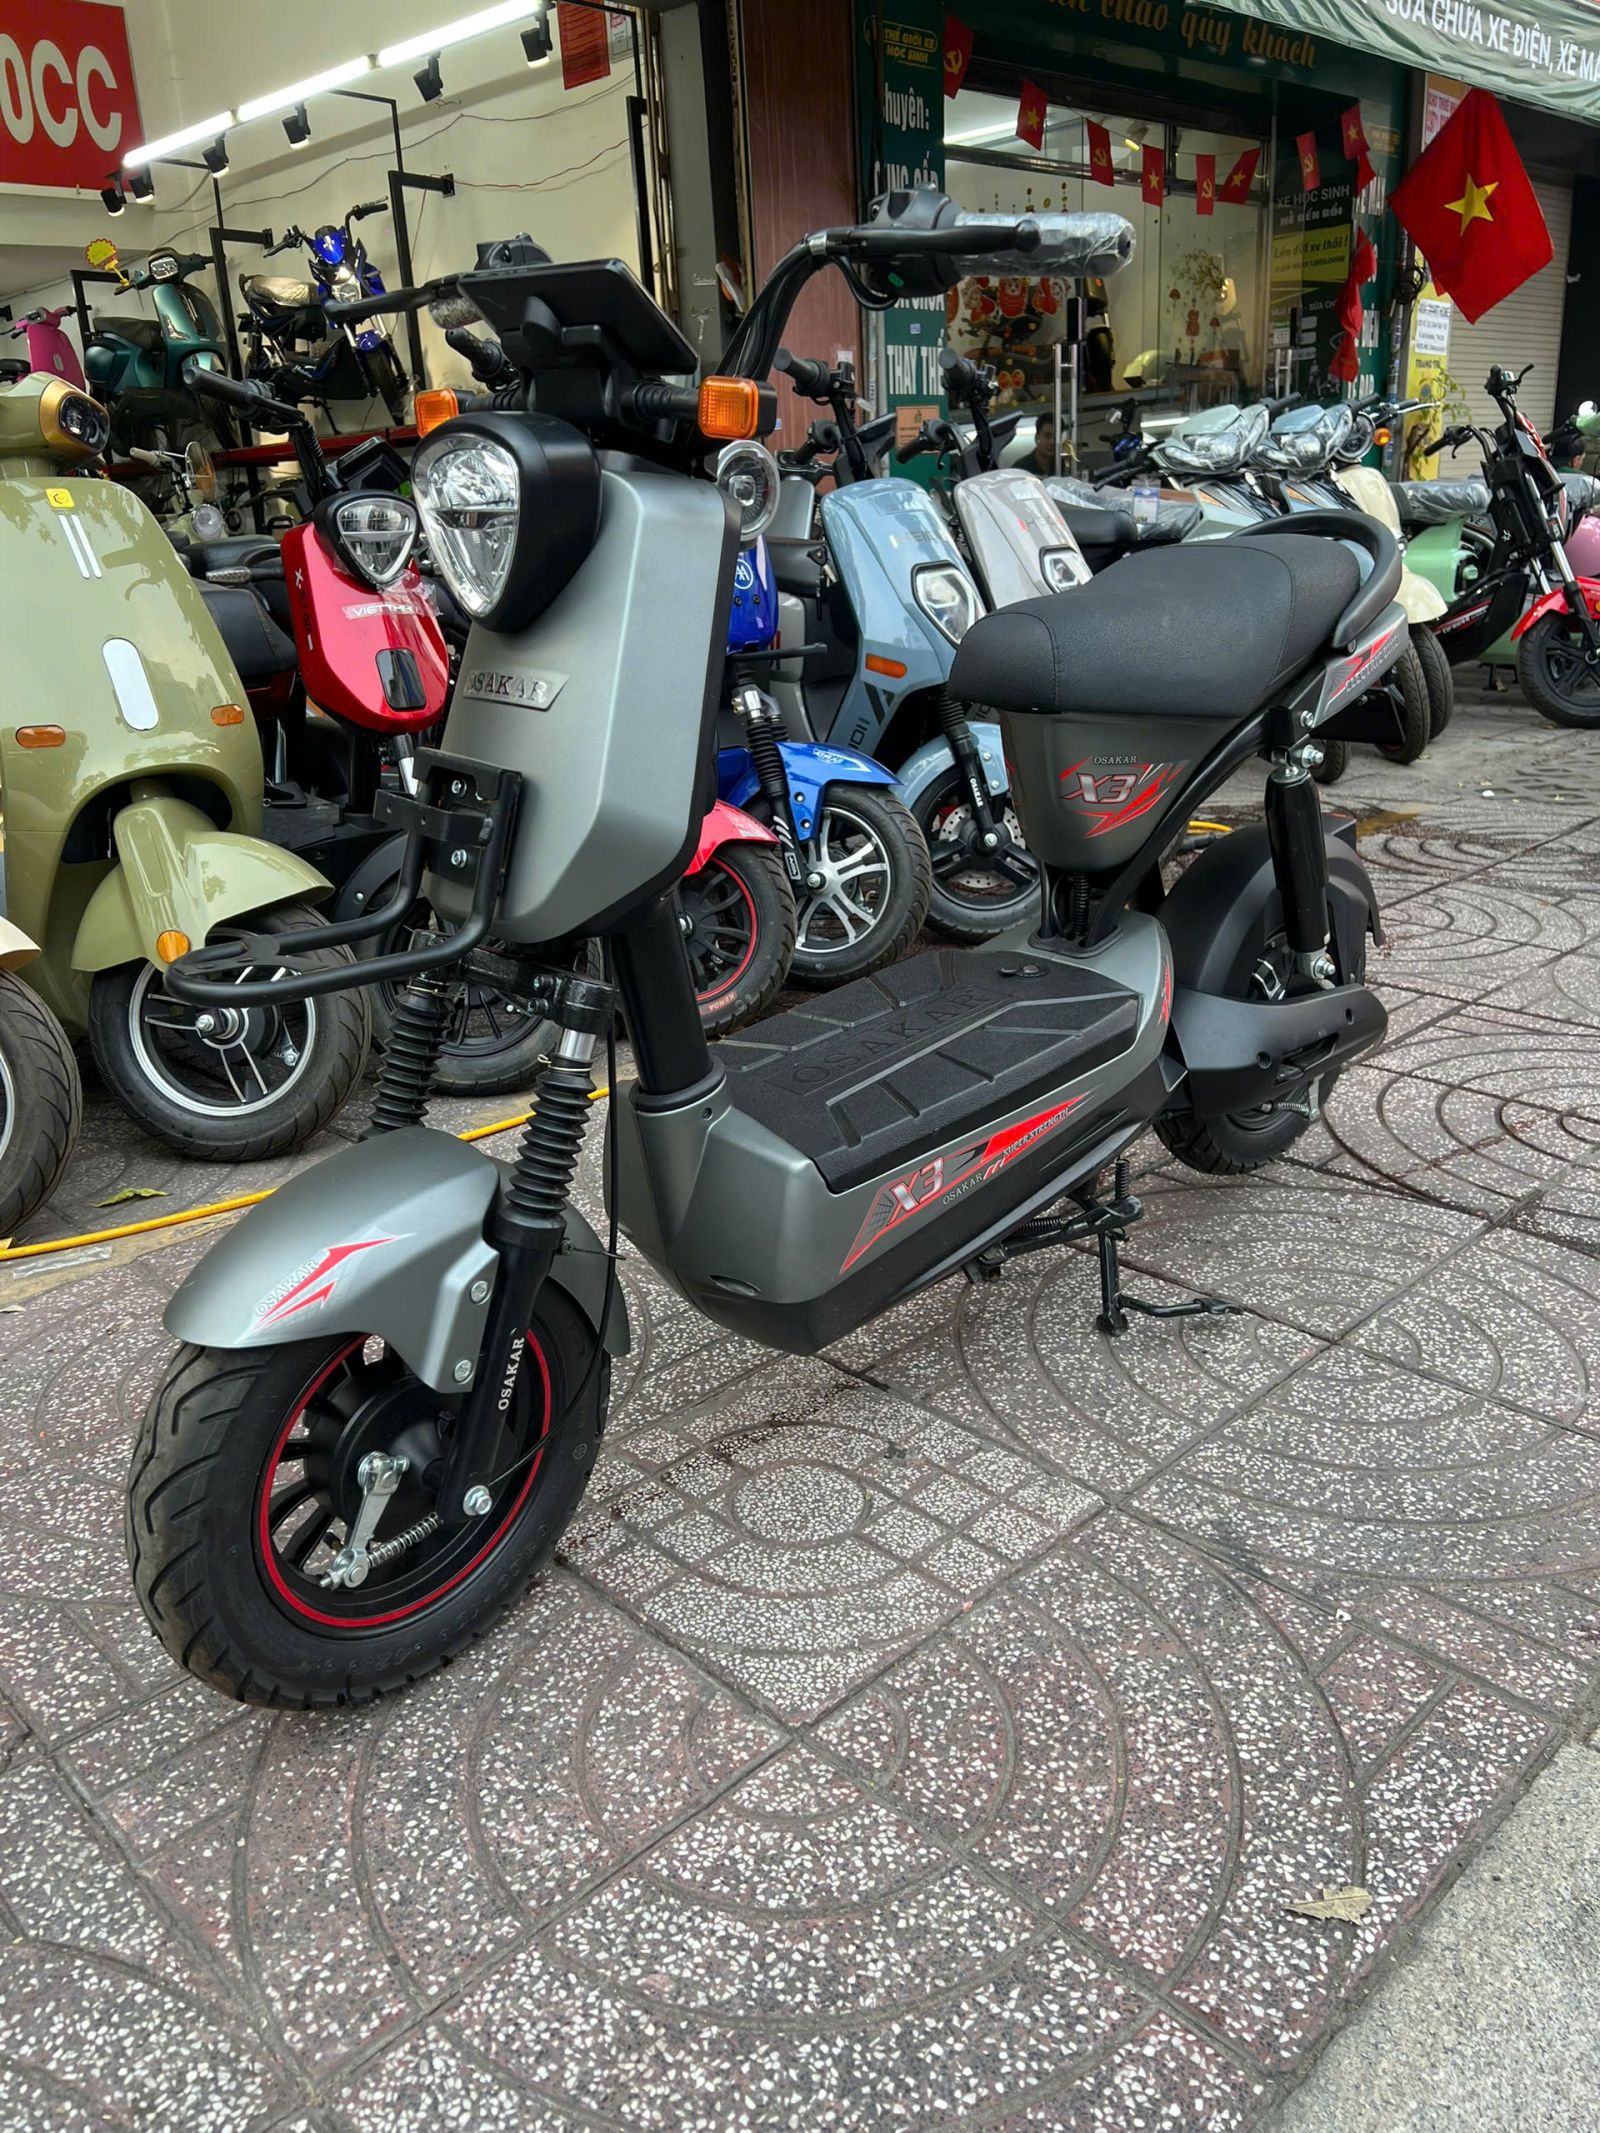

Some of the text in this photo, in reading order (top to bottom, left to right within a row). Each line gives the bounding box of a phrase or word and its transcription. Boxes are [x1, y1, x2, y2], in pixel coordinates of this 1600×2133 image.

[1487, 16, 1511, 50] XE
[1557, 40, 1579, 76] XE
[882, 82, 930, 131] huyên:
[1320, 184, 1350, 201] SINH
[886, 328, 945, 396] THAY THẾ
[1093, 755, 1138, 765] OSAKAR
[1060, 772, 1138, 804] X3
[708, 992, 737, 1012] KENDA
[792, 992, 980, 1083] OSAKAR
[887, 1156, 945, 1227] X3
[942, 1173, 984, 1206] OSAKAR
[255, 1259, 319, 1316] OSAKAR
[498, 1336, 526, 1411] OSAKAR
